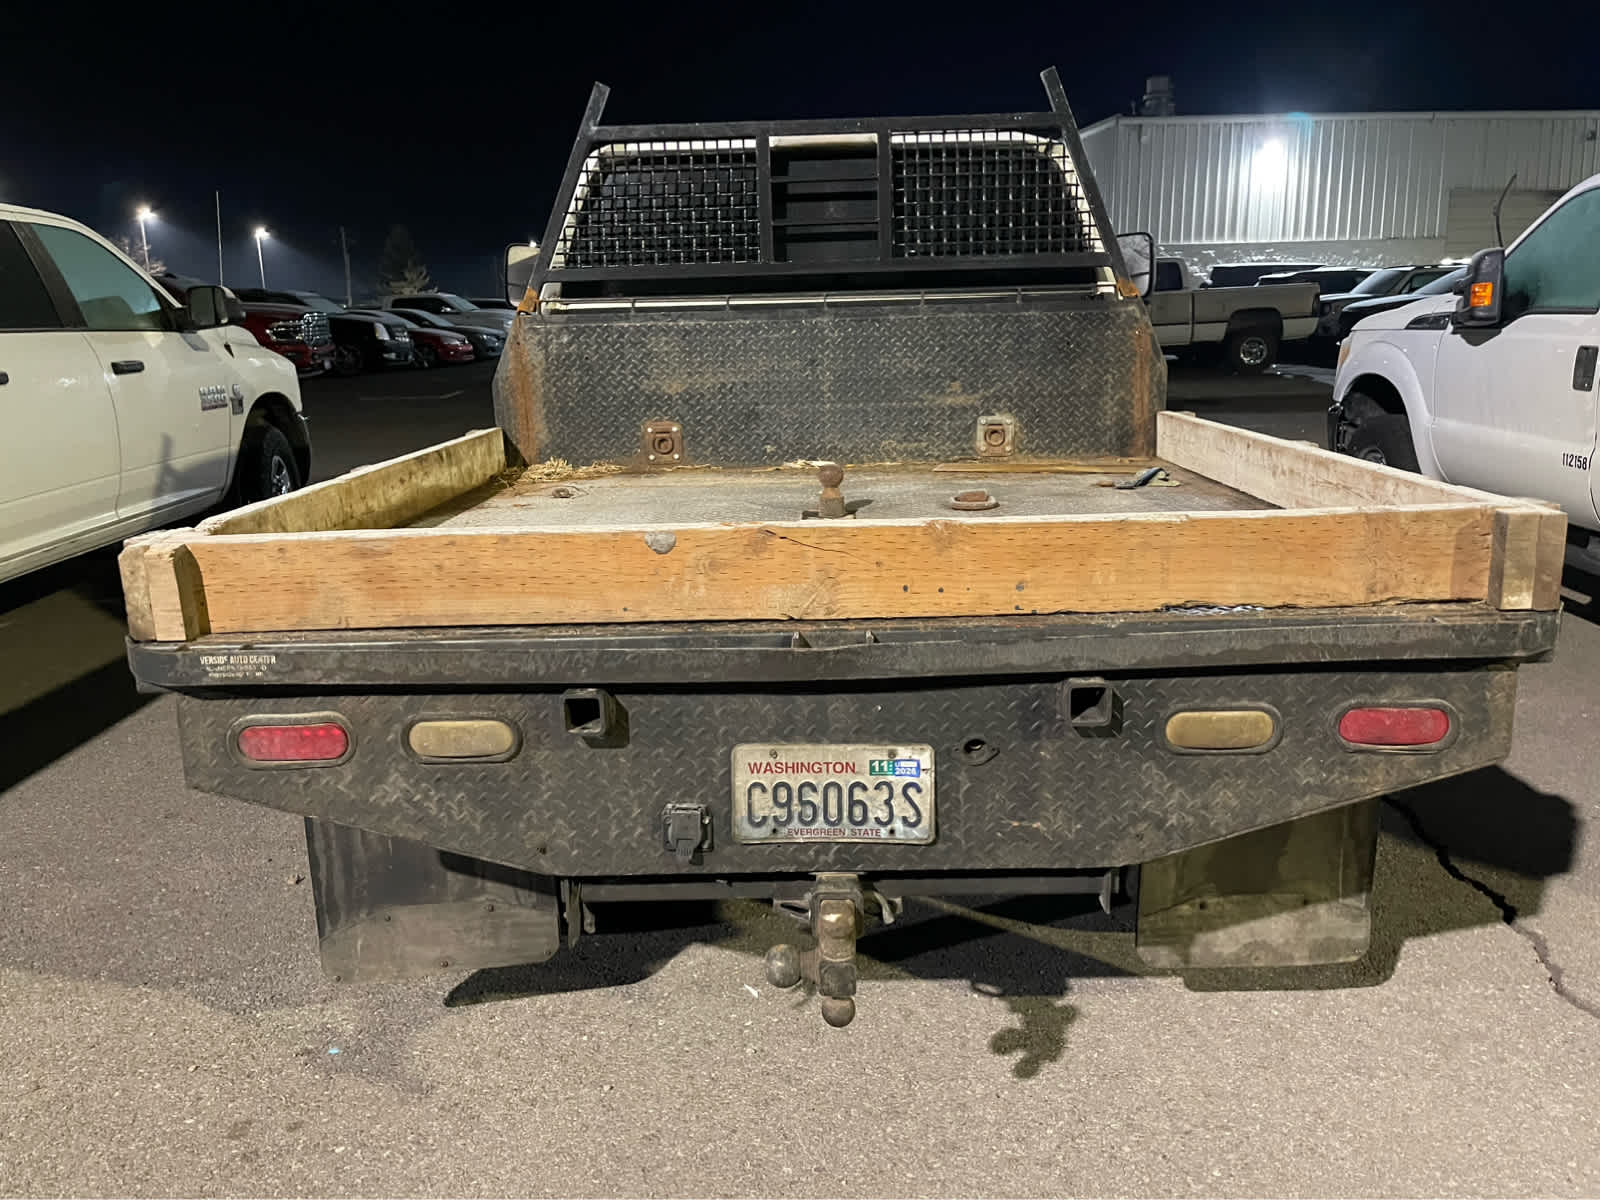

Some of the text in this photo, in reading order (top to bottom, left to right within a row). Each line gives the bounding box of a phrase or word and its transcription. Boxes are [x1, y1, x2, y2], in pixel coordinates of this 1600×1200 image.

[1562, 453, 1588, 470] 112158
[748, 761, 856, 774] WASHINGTON
[871, 760, 888, 773] 11
[747, 781, 923, 828] C96063S
[787, 828, 881, 837] EVERGREEN STATE
